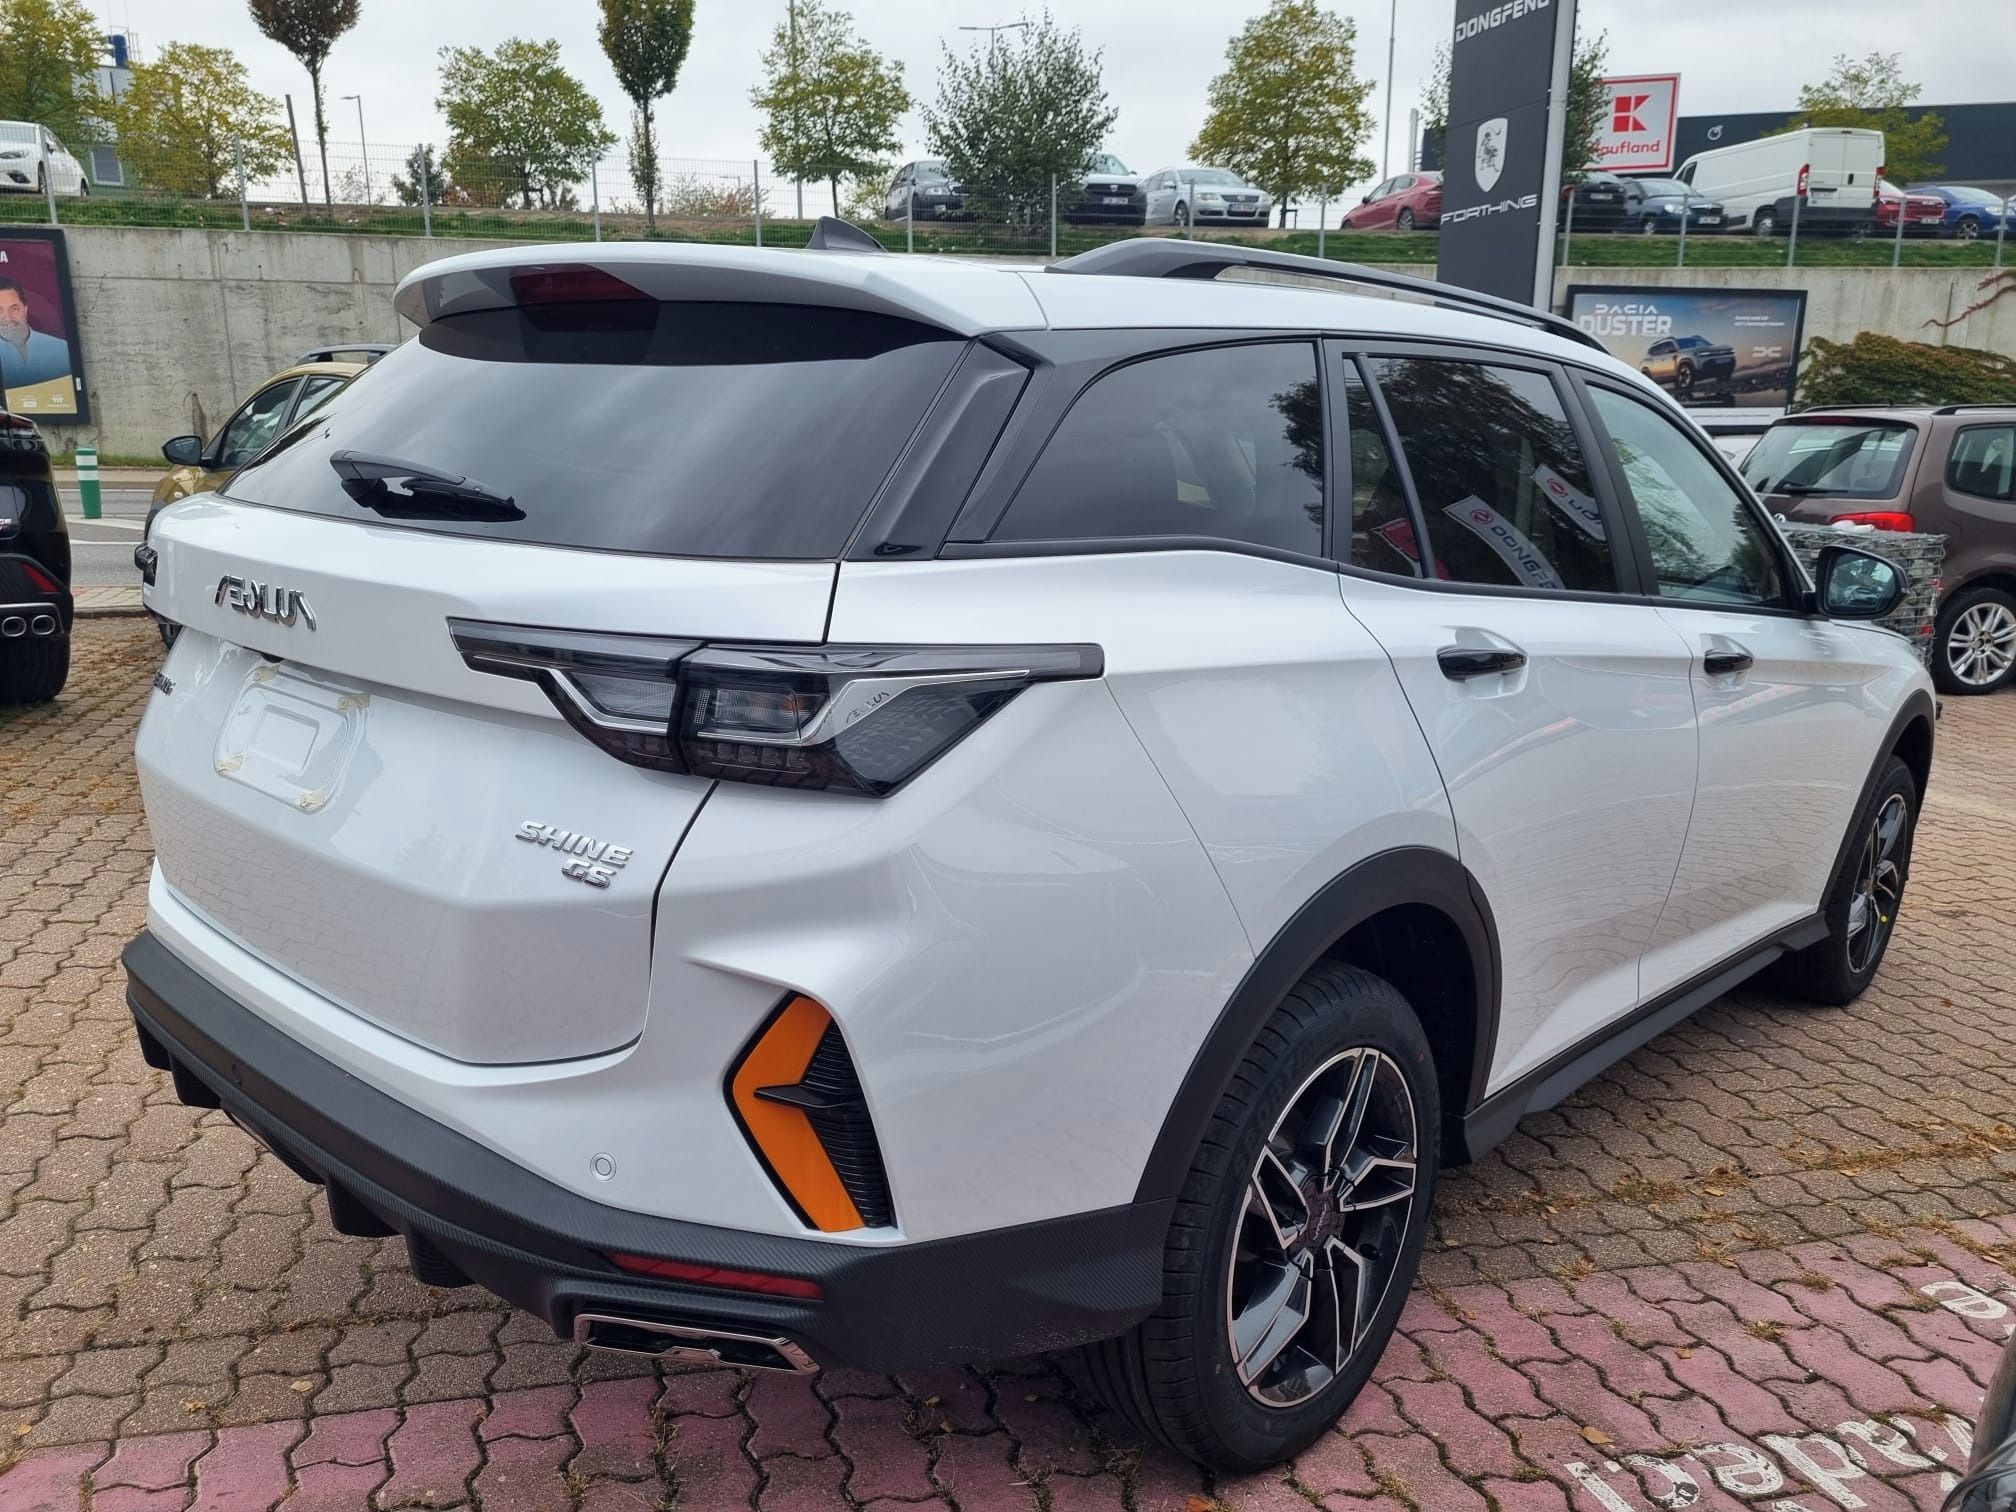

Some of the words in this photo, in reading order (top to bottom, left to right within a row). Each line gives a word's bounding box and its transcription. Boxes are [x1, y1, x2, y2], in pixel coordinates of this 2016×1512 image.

[1440, 194, 1538, 225] FORTHING
[1594, 303, 1658, 314] DACIA
[1579, 314, 1673, 337] DUSTER
[514, 820, 634, 869] SHINE
[561, 858, 617, 889] GS
